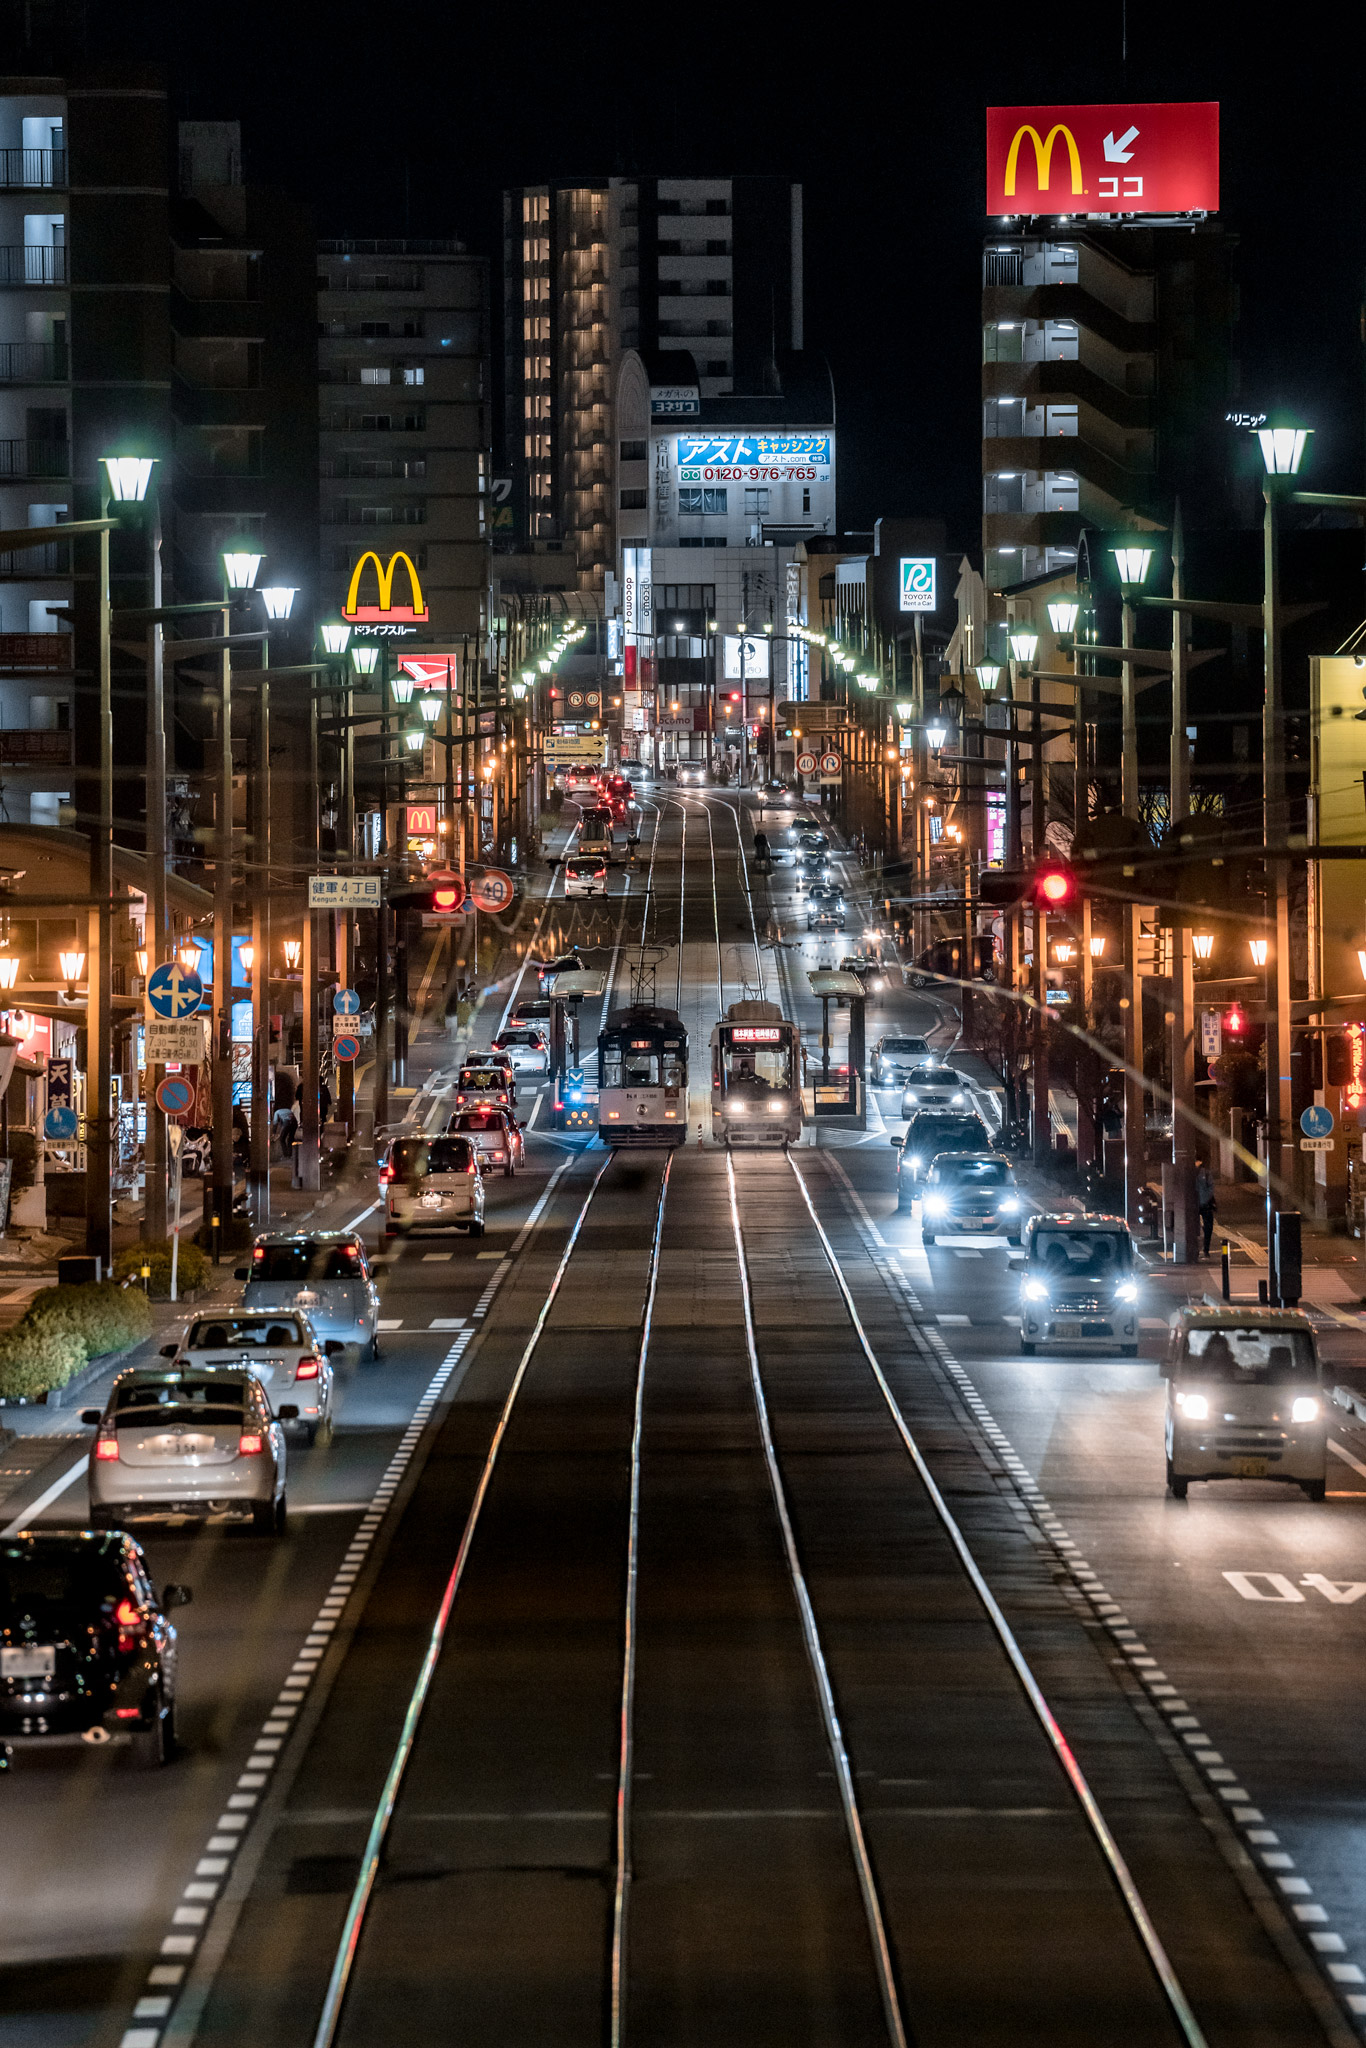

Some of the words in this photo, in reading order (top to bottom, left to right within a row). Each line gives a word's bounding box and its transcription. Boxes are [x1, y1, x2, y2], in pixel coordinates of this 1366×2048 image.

[1098, 176, 1144, 197] ココ
[656, 389, 694, 398] メガネの
[682, 440, 753, 463] アスト
[757, 440, 827, 453] キャッシング
[703, 467, 817, 481] 0120-976-765
[626, 577, 634, 617] docomo
[354, 625, 417, 636] ドライブスルー
[801, 758, 813, 769] 40
[312, 881, 377, 895] 健軍4丁目
[312, 896, 333, 904] Kengun
